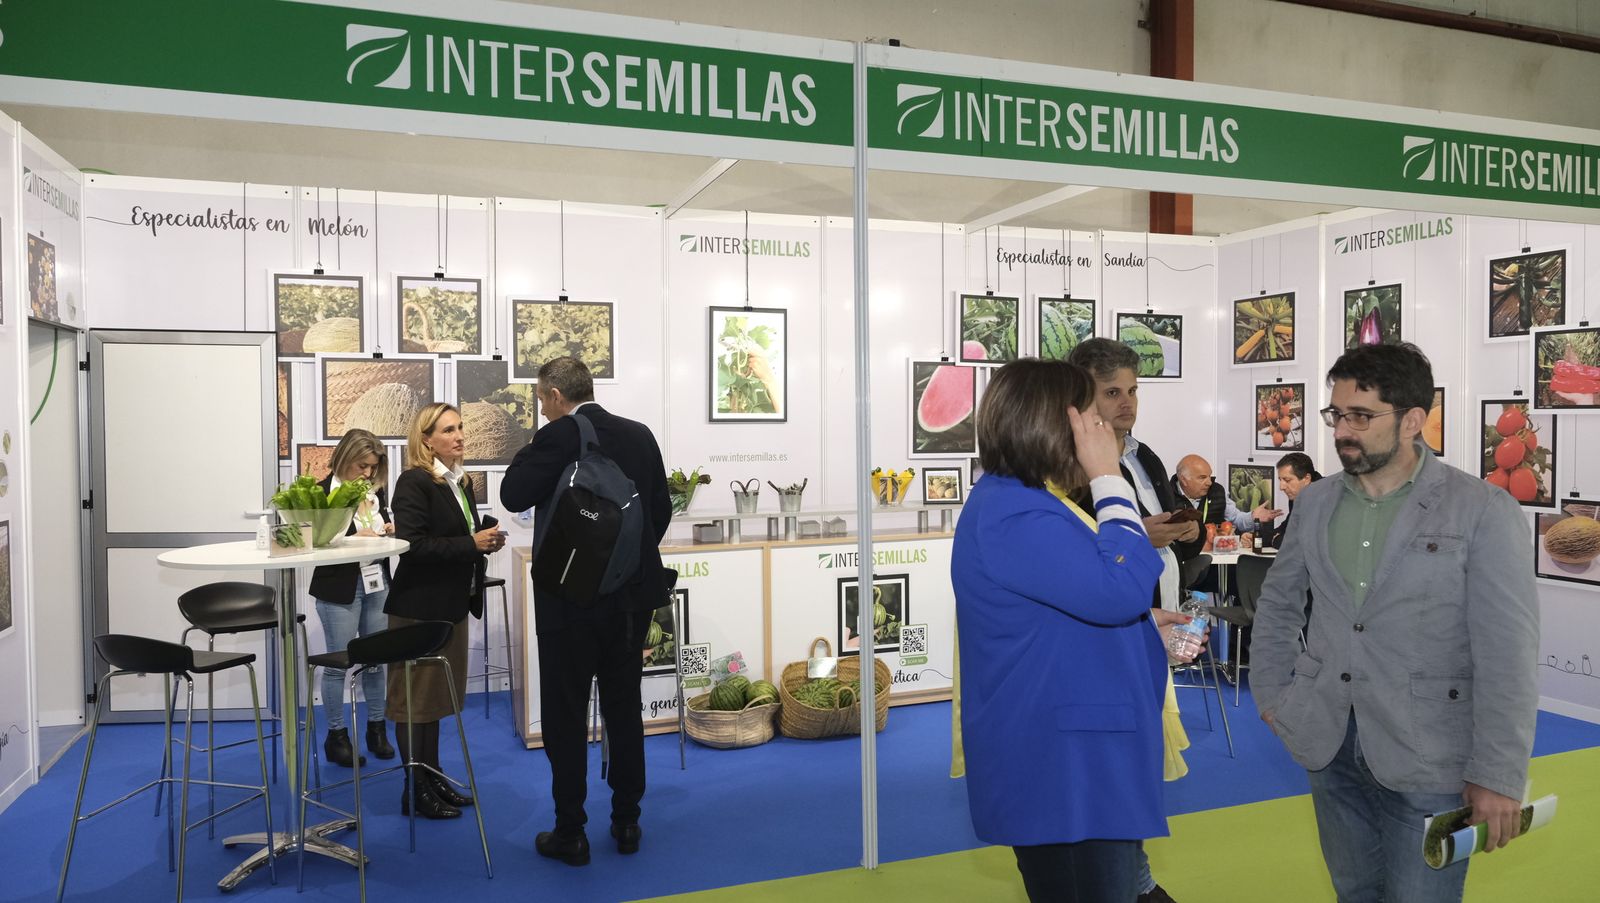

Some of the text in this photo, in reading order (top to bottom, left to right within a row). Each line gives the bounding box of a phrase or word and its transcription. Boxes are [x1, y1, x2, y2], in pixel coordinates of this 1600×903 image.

[426, 34, 817, 127] INTERSEMILLAS
[954, 90, 1239, 164] INTERSEMILLAS
[32, 172, 79, 221] INTERSEMILLAS
[131, 205, 369, 238] Especialistas en Melón
[1350, 216, 1453, 252] INTERSEMILLAS
[700, 235, 811, 258] INTERSEMILLAS
[996, 247, 1146, 272] Especialistas en Sandía
[708, 452, 788, 463] www.intersemillas.es
[579, 508, 599, 520] cool
[835, 548, 927, 568] INTESEMILLAS
